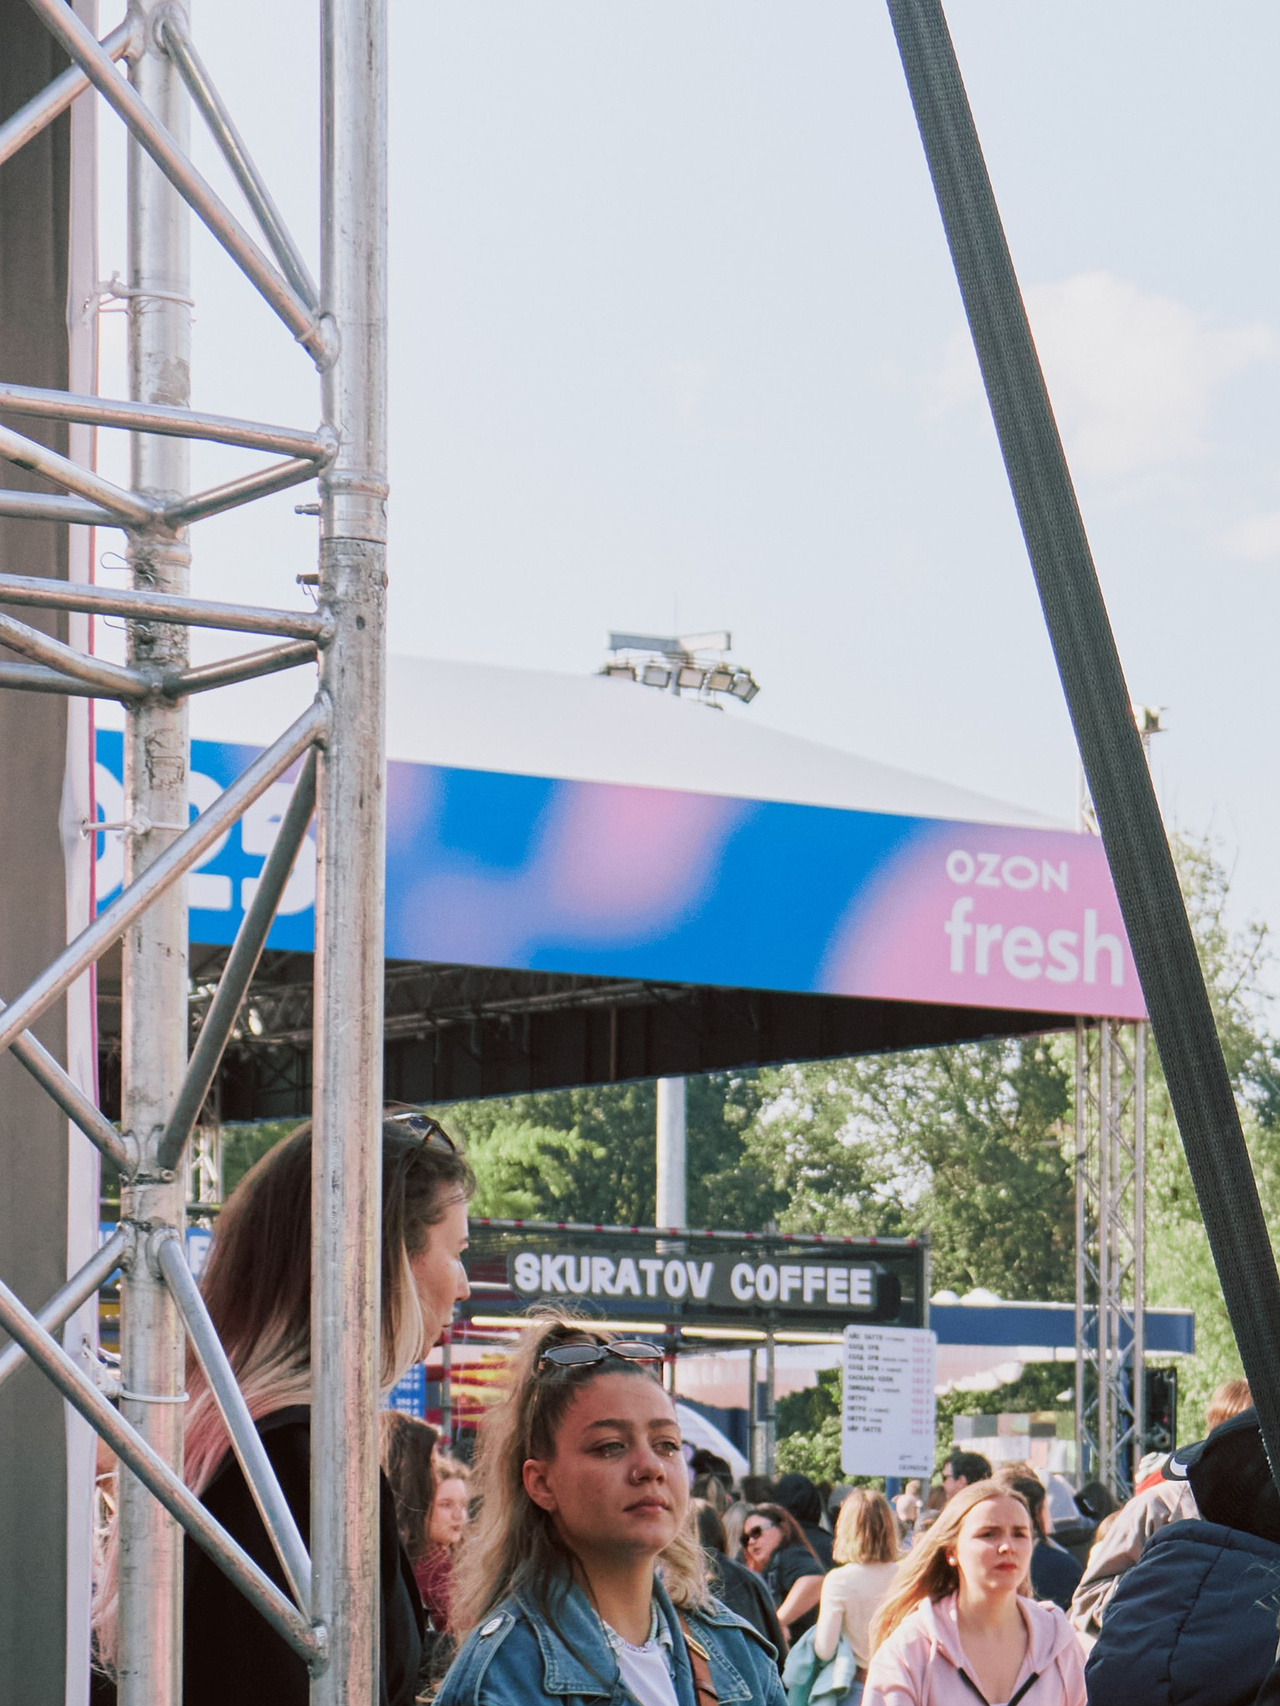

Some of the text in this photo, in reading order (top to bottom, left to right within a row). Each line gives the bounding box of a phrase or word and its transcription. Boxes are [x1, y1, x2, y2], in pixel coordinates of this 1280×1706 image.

[944, 896, 1125, 987] fresh
[513, 1252, 873, 1305] SKURATOV COFFEE
